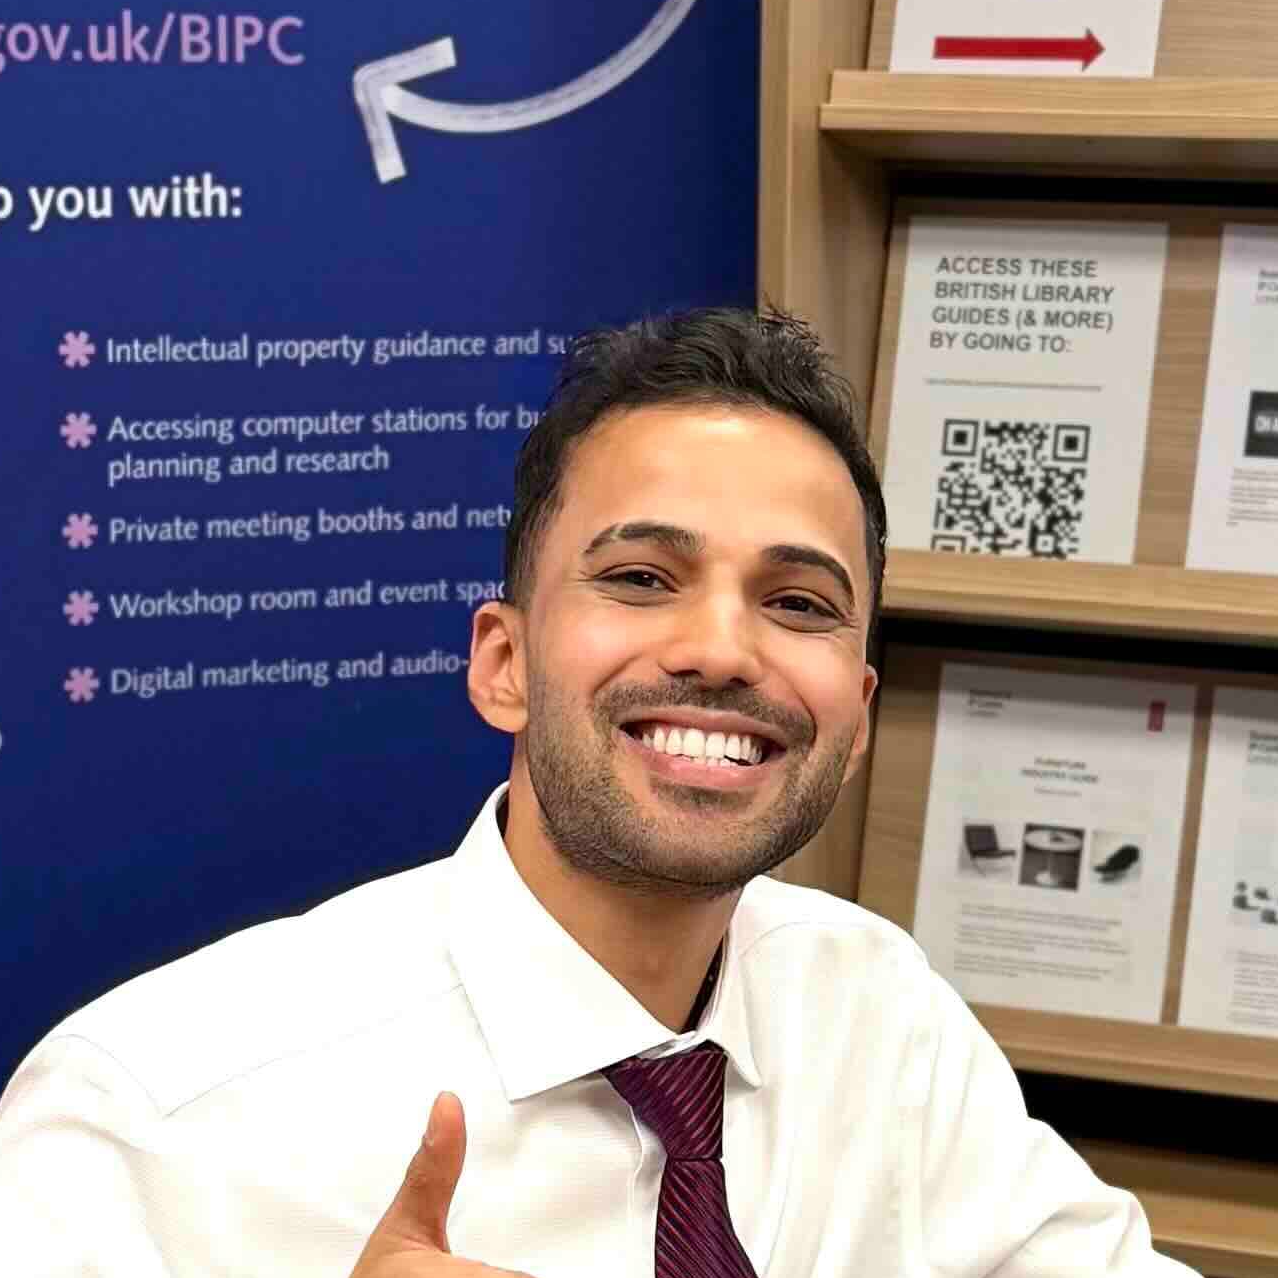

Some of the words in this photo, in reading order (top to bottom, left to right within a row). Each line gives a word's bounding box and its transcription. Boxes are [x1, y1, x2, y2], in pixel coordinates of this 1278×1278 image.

[29, 187, 111, 231] you
[129, 173, 241, 217] with:
[938, 256, 1022, 275] ACCESS
[1029, 258, 1098, 277] THESE
[935, 282, 1016, 300] BRITISH
[1023, 285, 1114, 303] LIBRARY
[932, 306, 1009, 325] GUIDES
[1016, 309, 1037, 330] (&
[1044, 311, 1112, 331] MORE)
[108, 334, 247, 362] Intellectual
[258, 335, 365, 367] property
[374, 331, 485, 364] guidance
[494, 330, 538, 354] and
[930, 331, 958, 348] BY
[963, 332, 1031, 351] GOING
[1038, 335, 1072, 353] TO:
[108, 417, 234, 444] Accessing
[242, 411, 364, 442] computer
[372, 409, 466, 432] stations
[476, 404, 509, 429] for
[109, 453, 220, 487] planning
[230, 449, 276, 474] and
[287, 445, 388, 472] research
[110, 517, 198, 542] Private
[207, 513, 310, 541] meeting
[319, 506, 404, 533] booths
[412, 504, 457, 530] and
[110, 589, 242, 618] Workshop
[251, 590, 316, 610] room
[325, 580, 371, 607] and
[380, 580, 447, 604] event
[111, 663, 193, 698] Digital
[203, 660, 329, 686] marketing
[337, 652, 383, 678] and
